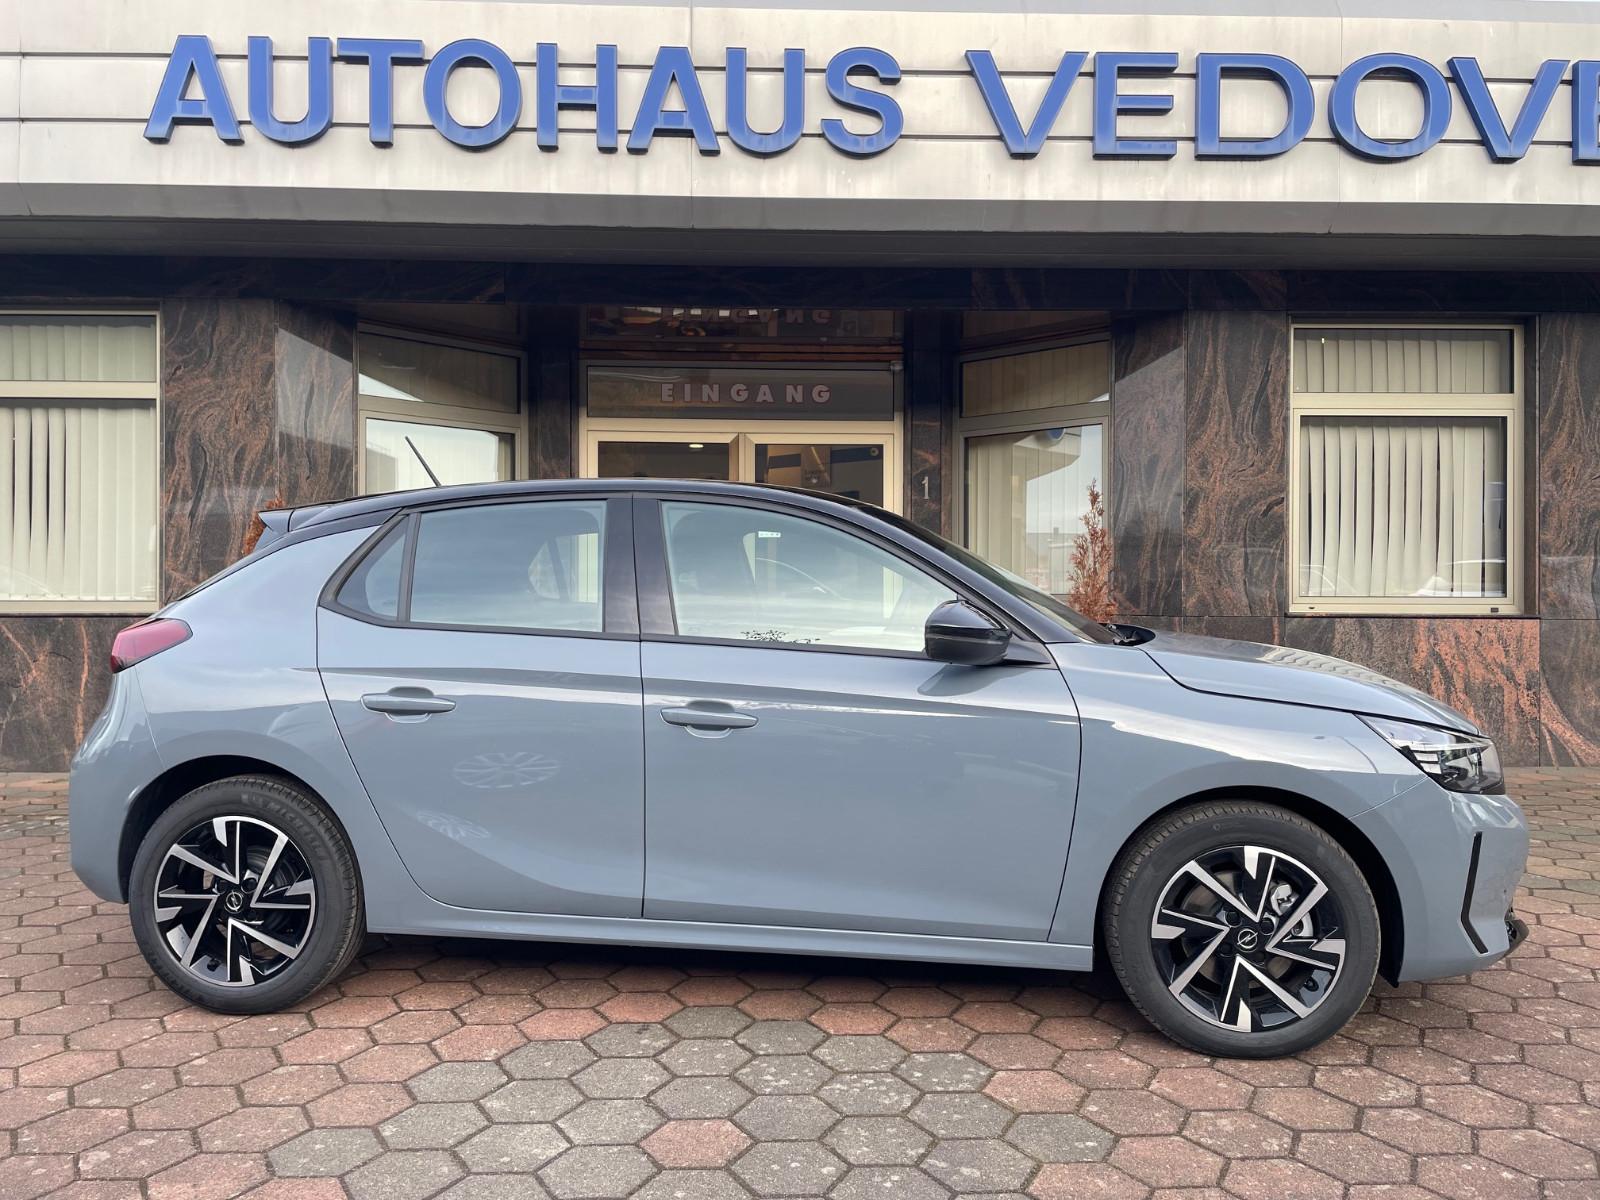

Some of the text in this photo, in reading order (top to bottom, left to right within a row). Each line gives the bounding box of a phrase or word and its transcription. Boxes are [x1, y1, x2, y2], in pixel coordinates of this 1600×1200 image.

[145, 36, 903, 156] AUTOHAUS
[661, 383, 832, 403] EINGANG
[921, 476, 929, 500] 1
